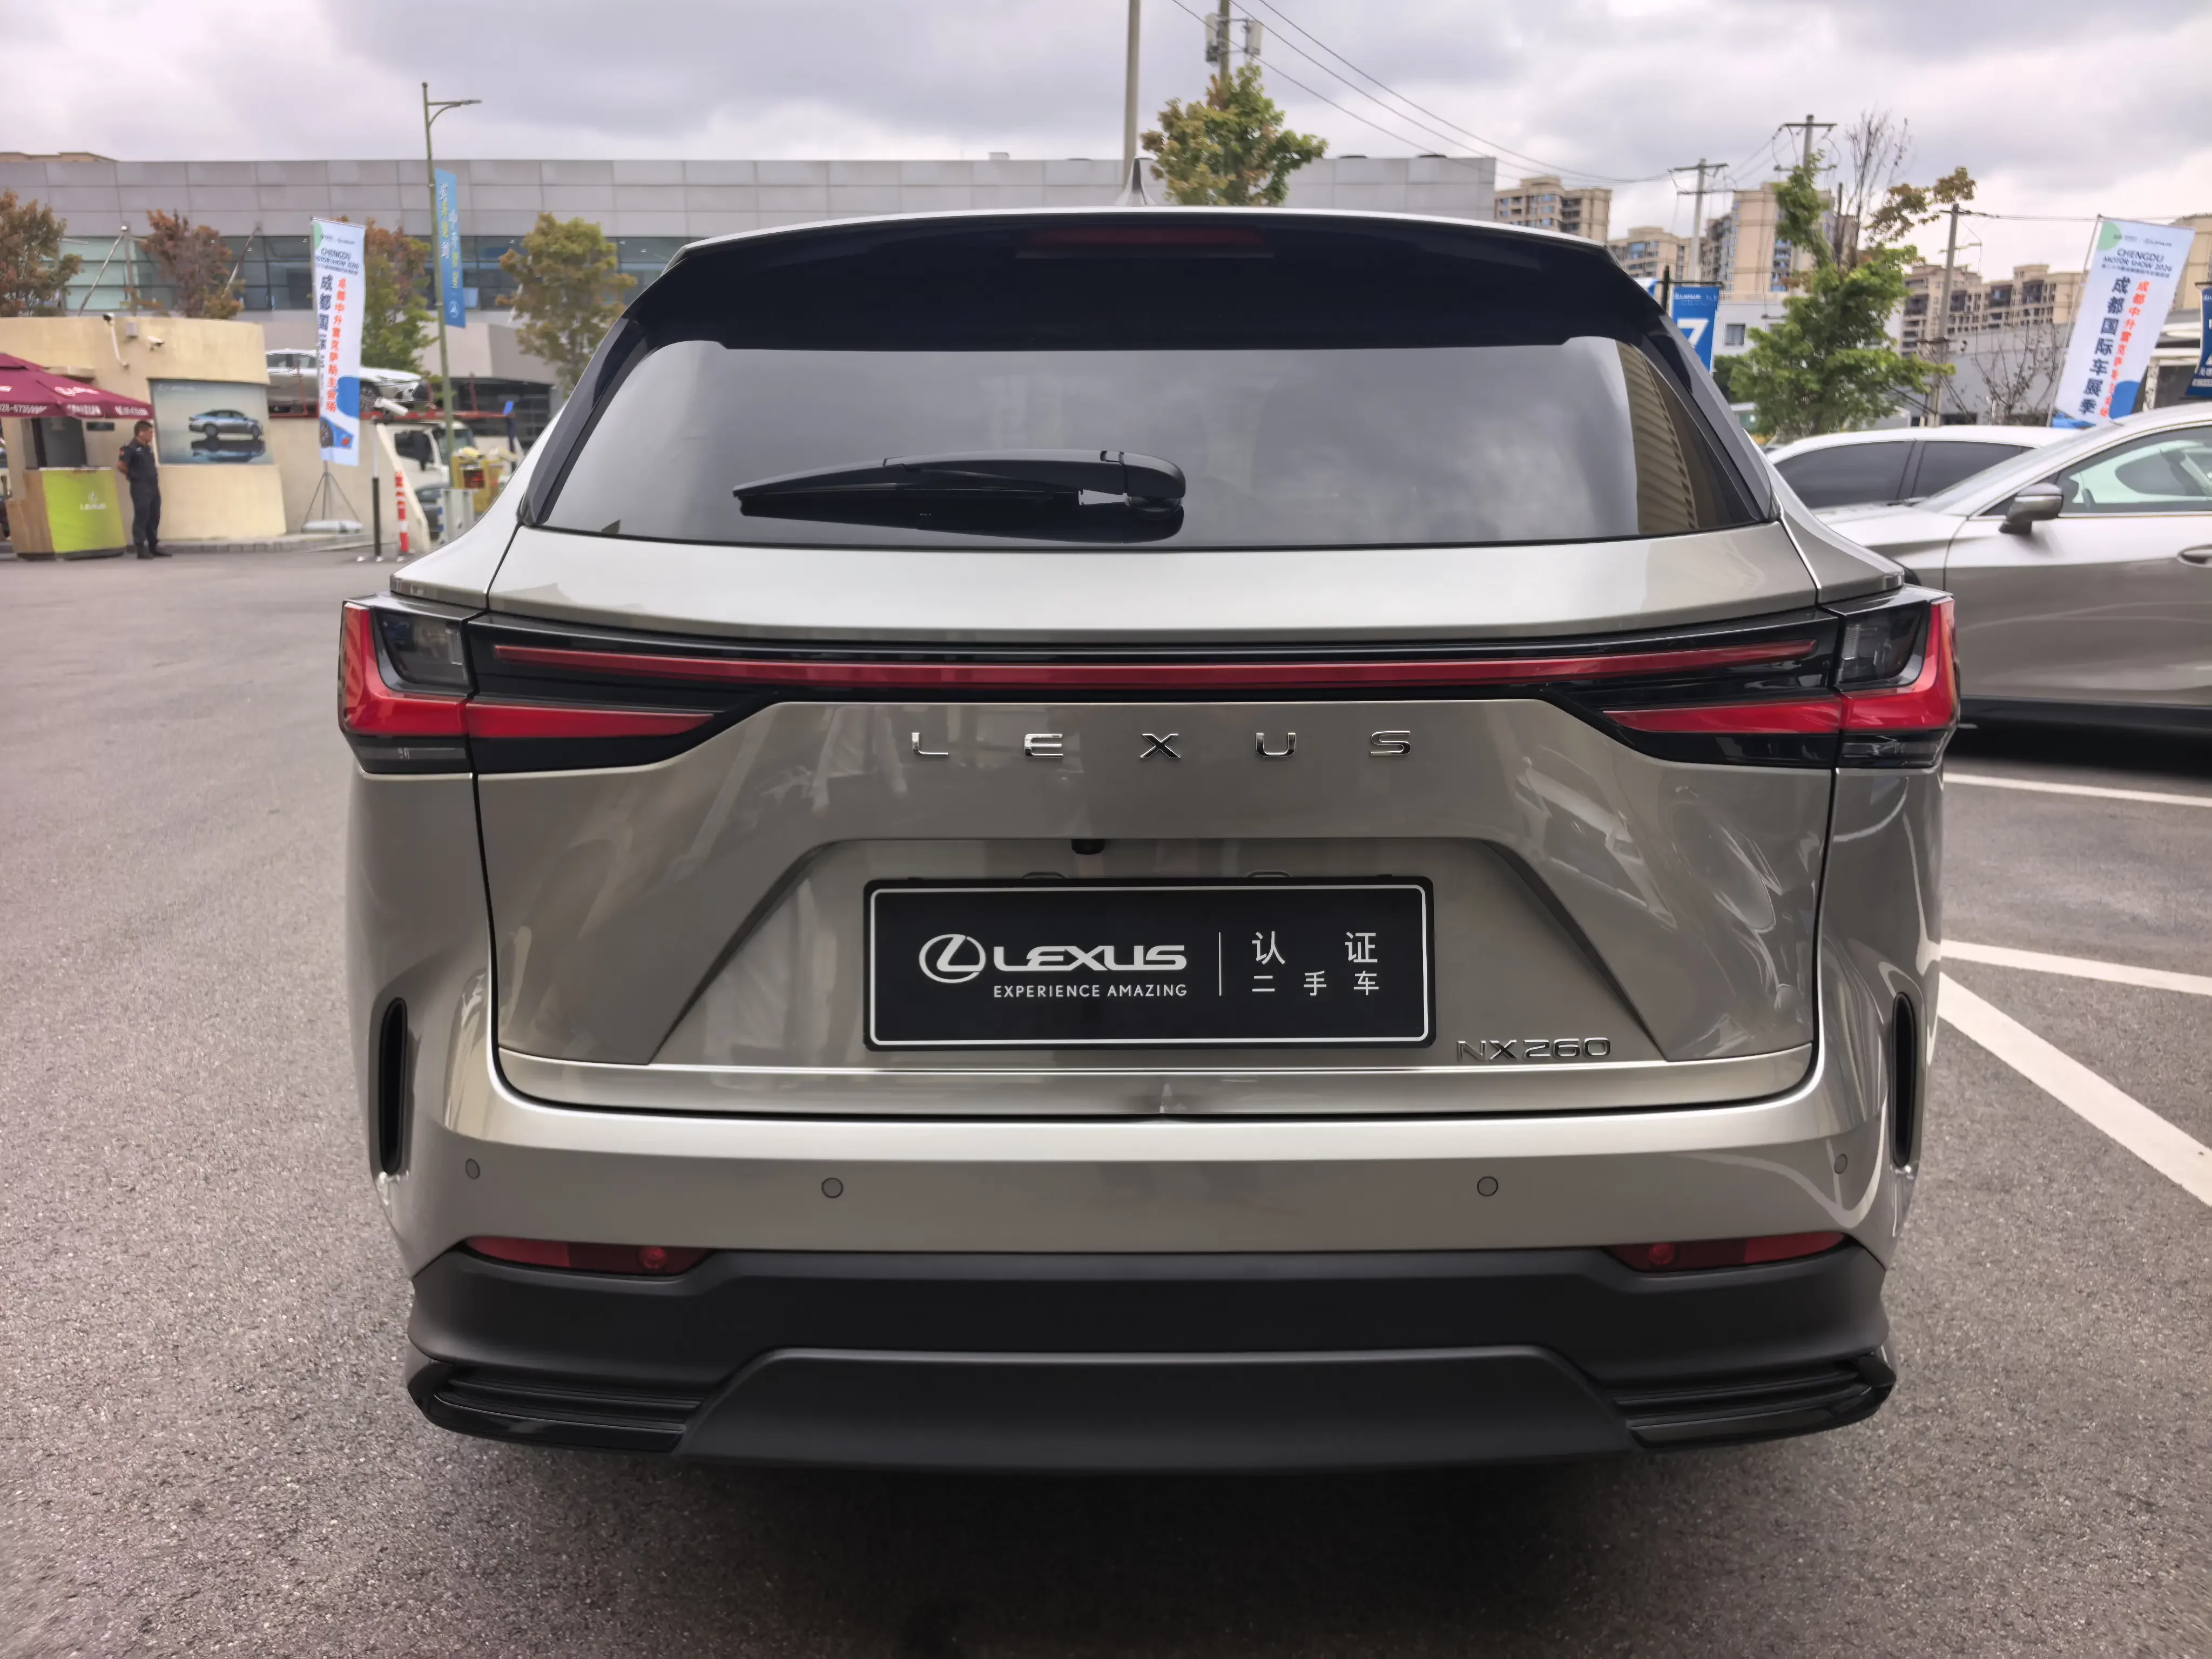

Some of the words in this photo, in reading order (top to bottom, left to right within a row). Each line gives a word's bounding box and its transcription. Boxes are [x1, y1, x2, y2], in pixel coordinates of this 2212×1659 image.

[2117, 248, 2164, 262] CHENGDU
[2078, 276, 2131, 415] 成都国际车展季
[911, 731, 1412, 758] LEXUS
[993, 945, 1187, 972] LEXUS
[1252, 930, 1378, 965] 认证
[994, 984, 1100, 998] EXPERIENCE
[1107, 984, 1188, 997] AMAZING
[1252, 970, 1379, 996] 二手车
